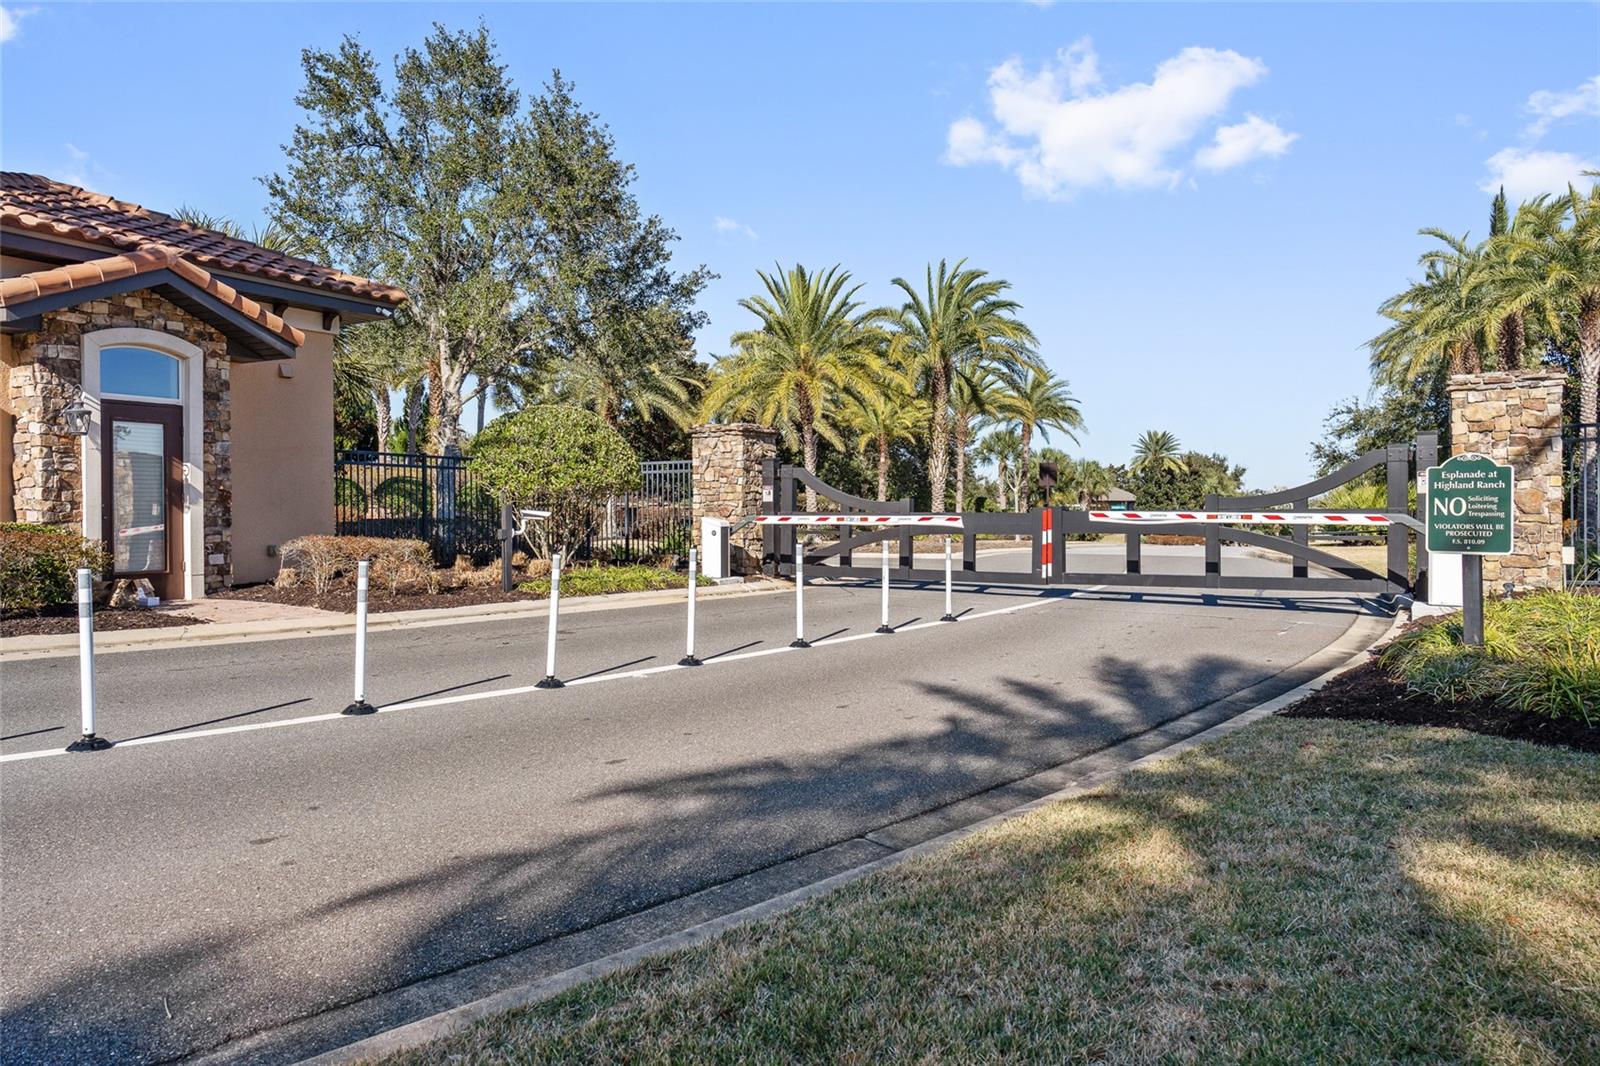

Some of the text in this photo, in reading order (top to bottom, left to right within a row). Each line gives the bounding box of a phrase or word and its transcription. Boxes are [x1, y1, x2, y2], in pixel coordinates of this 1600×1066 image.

[1441, 470, 1498, 481] Esplanade at
[1434, 481, 1475, 491] Highland
[1477, 480, 1505, 489] Ranch
[1434, 497, 1467, 516] NO
